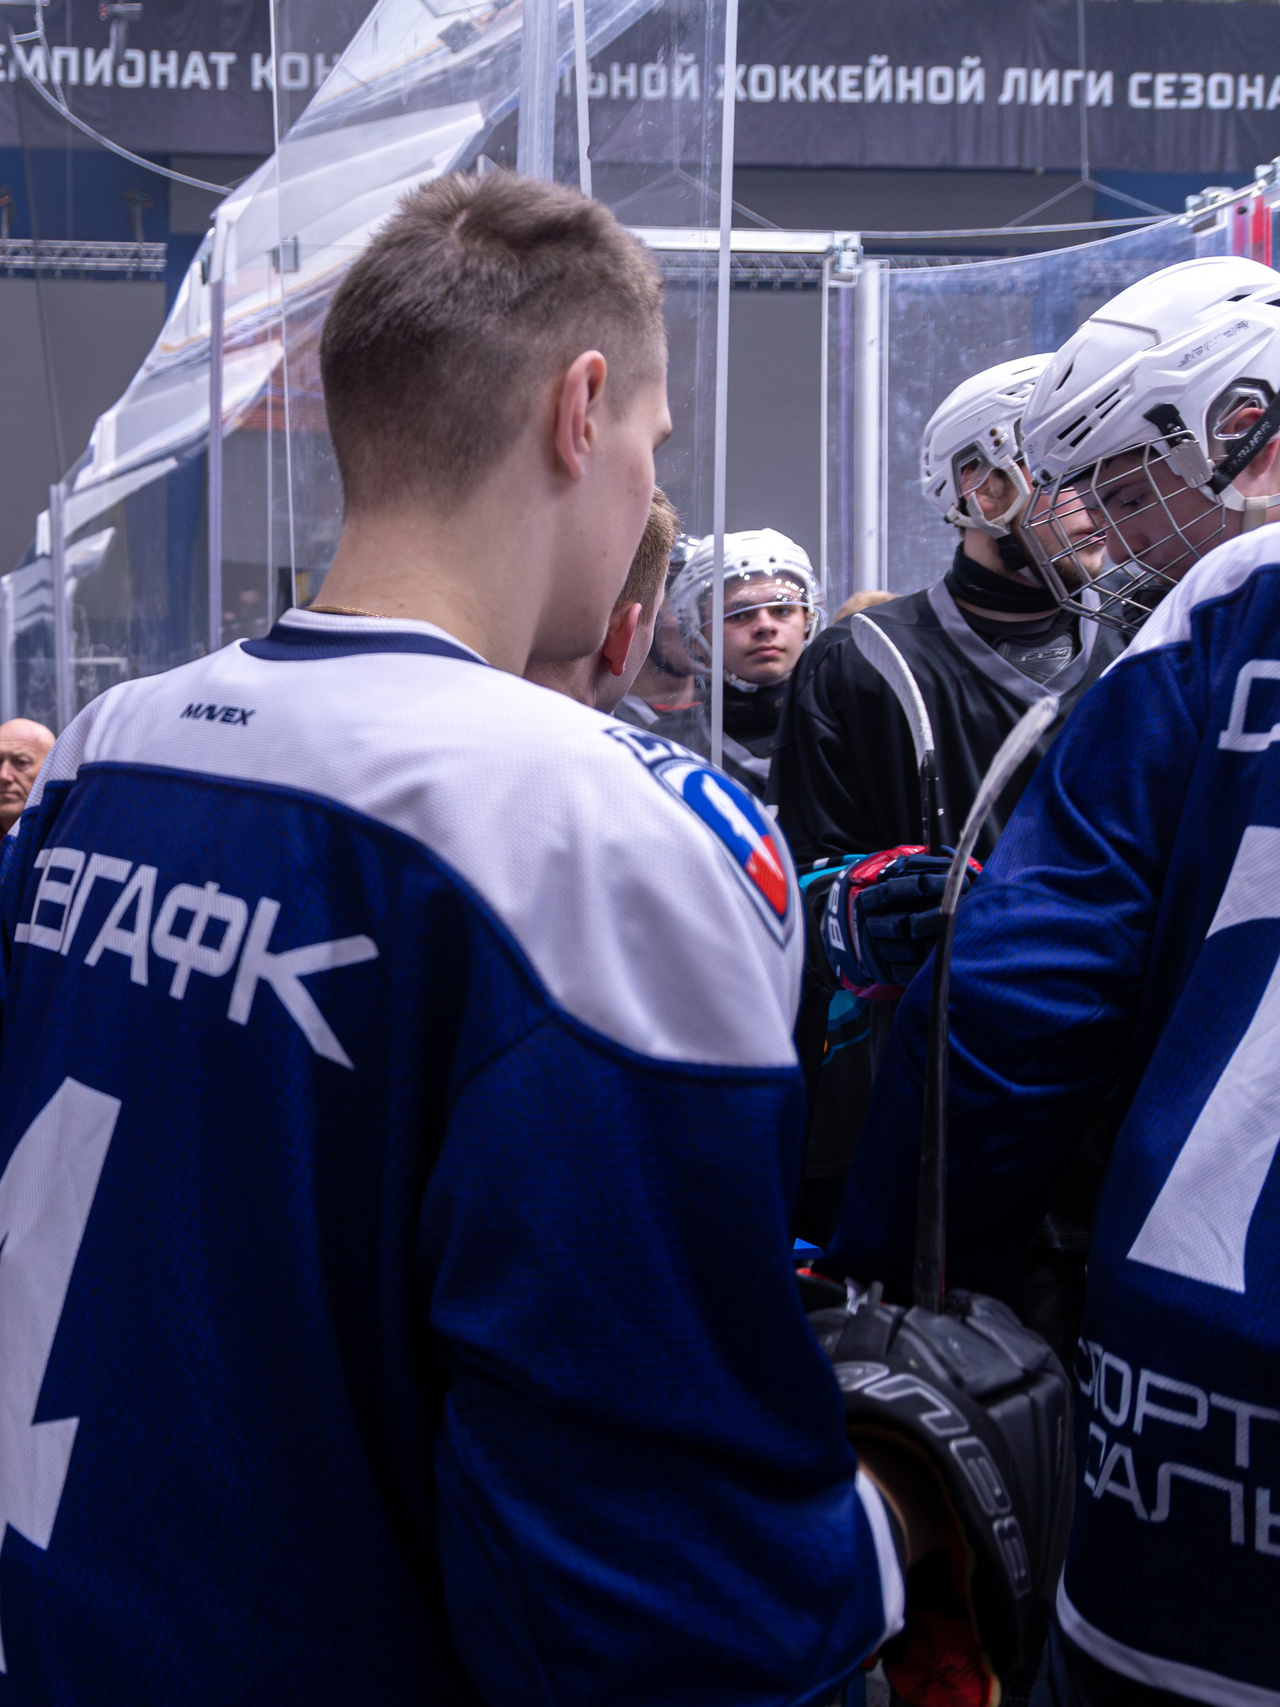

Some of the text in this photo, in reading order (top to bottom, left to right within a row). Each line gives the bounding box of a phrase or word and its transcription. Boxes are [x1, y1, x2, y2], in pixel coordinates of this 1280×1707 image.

[715, 54, 986, 105] ХОККЕЙНОЙ
[997, 67, 1114, 107] ЛИГИ
[14, 846, 380, 1070] ВГАФК
